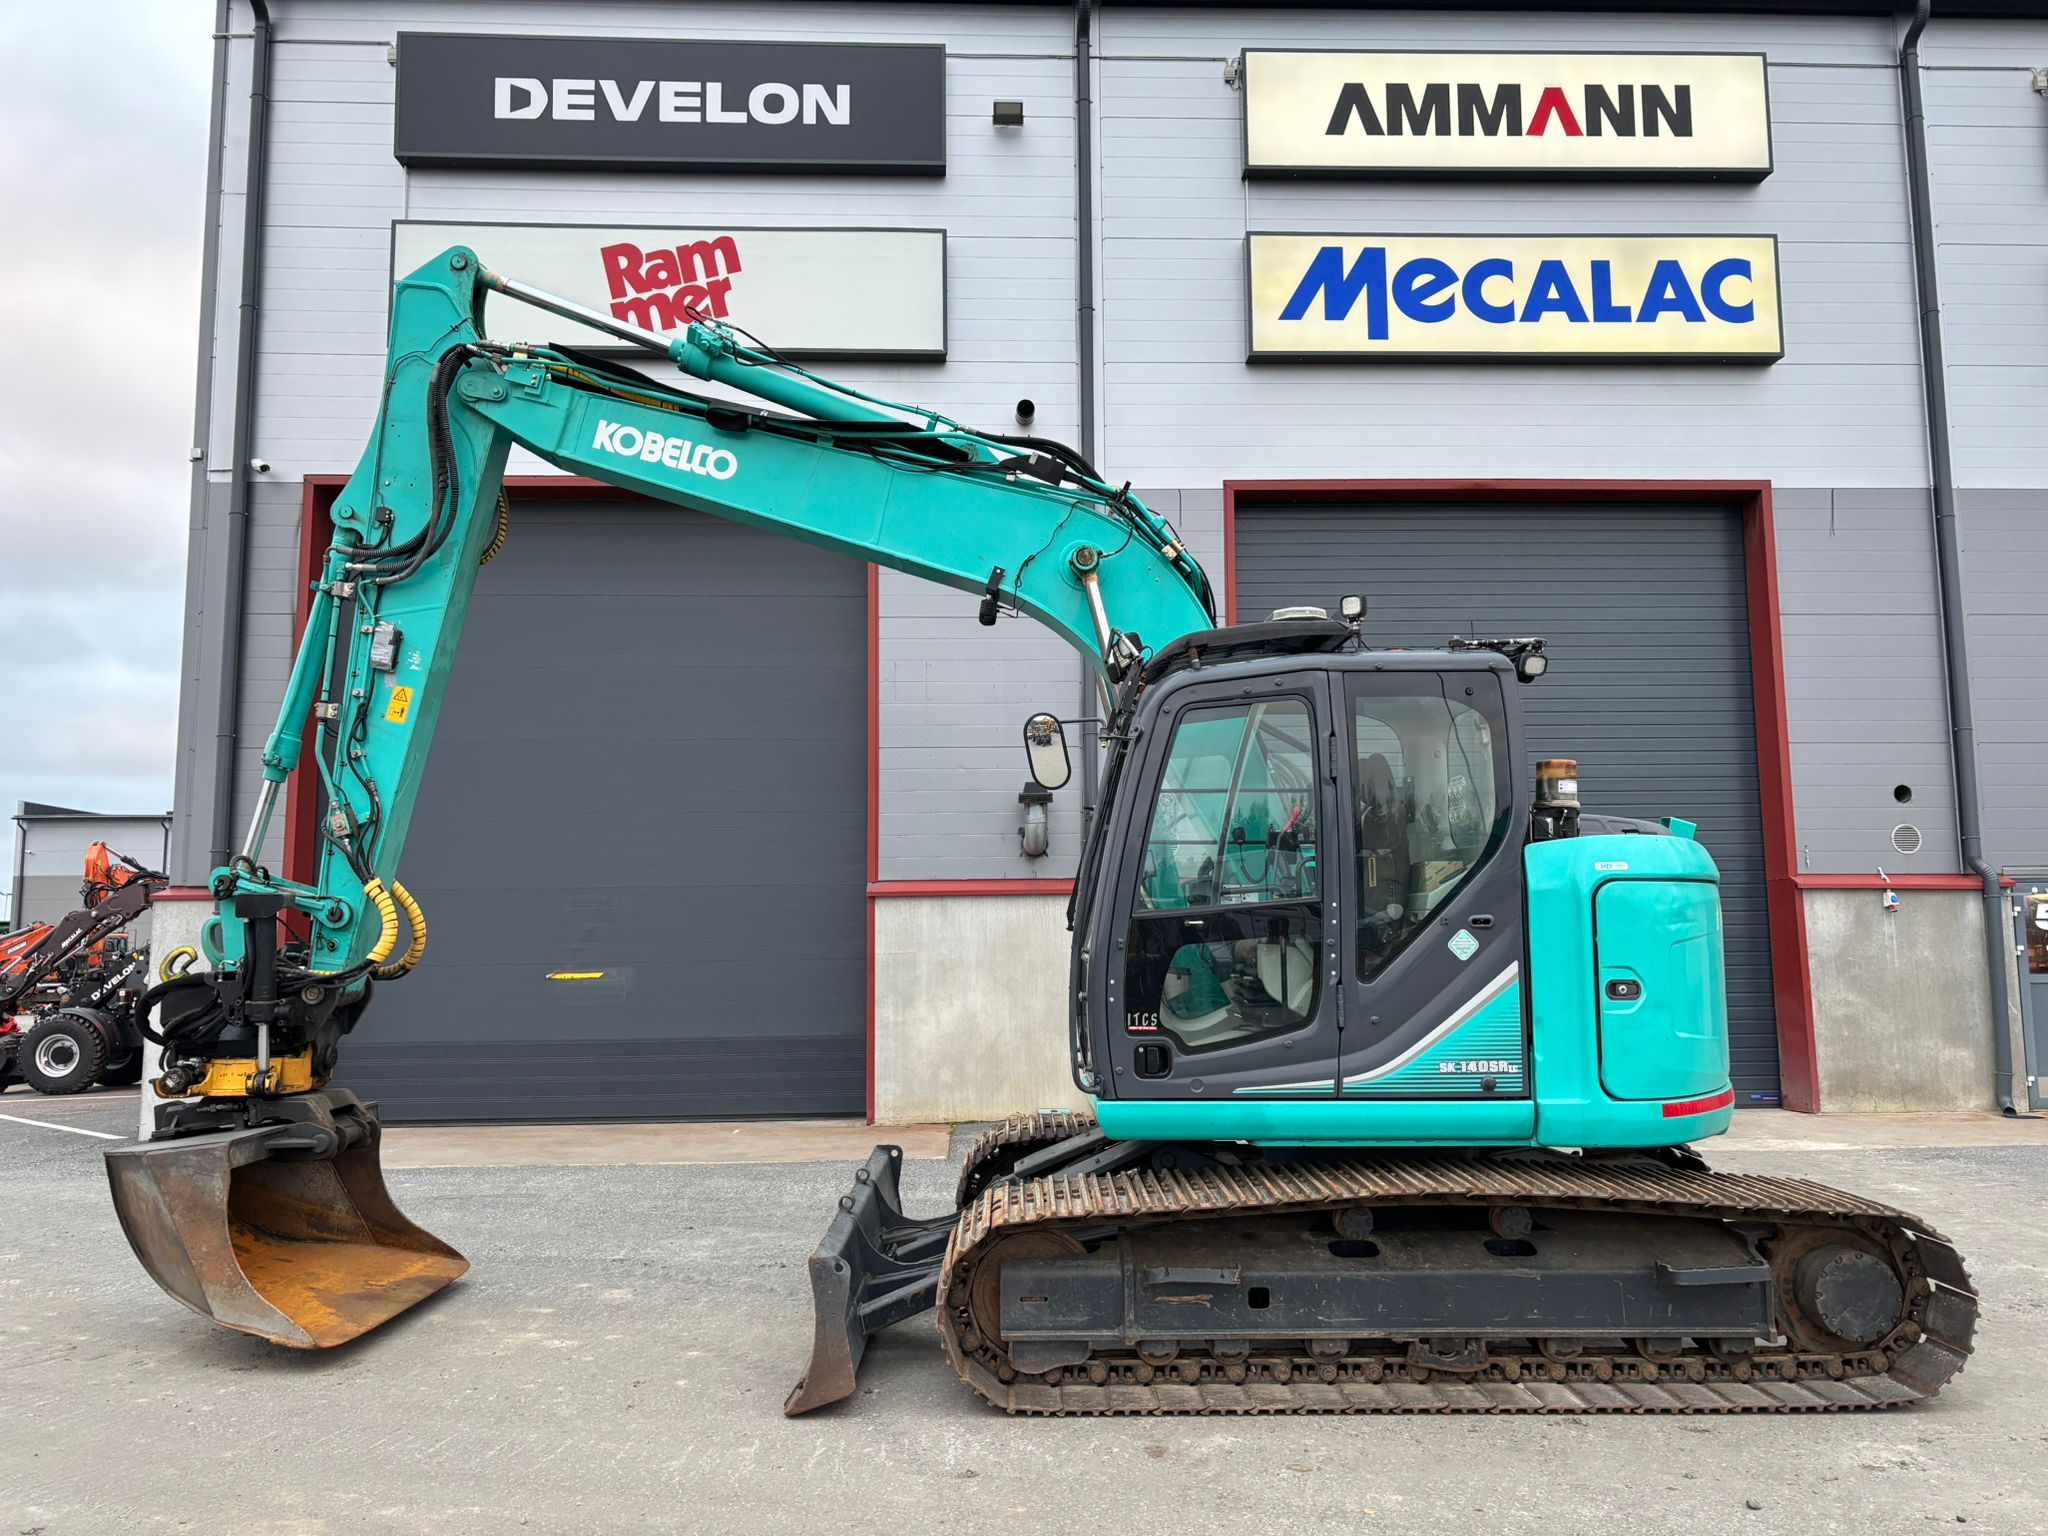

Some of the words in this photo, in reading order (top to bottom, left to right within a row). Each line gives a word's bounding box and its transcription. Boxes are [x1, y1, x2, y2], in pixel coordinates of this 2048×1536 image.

[494, 77, 850, 125] DEVELON
[1325, 82, 1693, 137] AMMANN
[600, 235, 742, 299] Ram
[610, 276, 732, 332] mer
[592, 419, 738, 480] KOBELCO
[1439, 1061, 1457, 1073] SK
